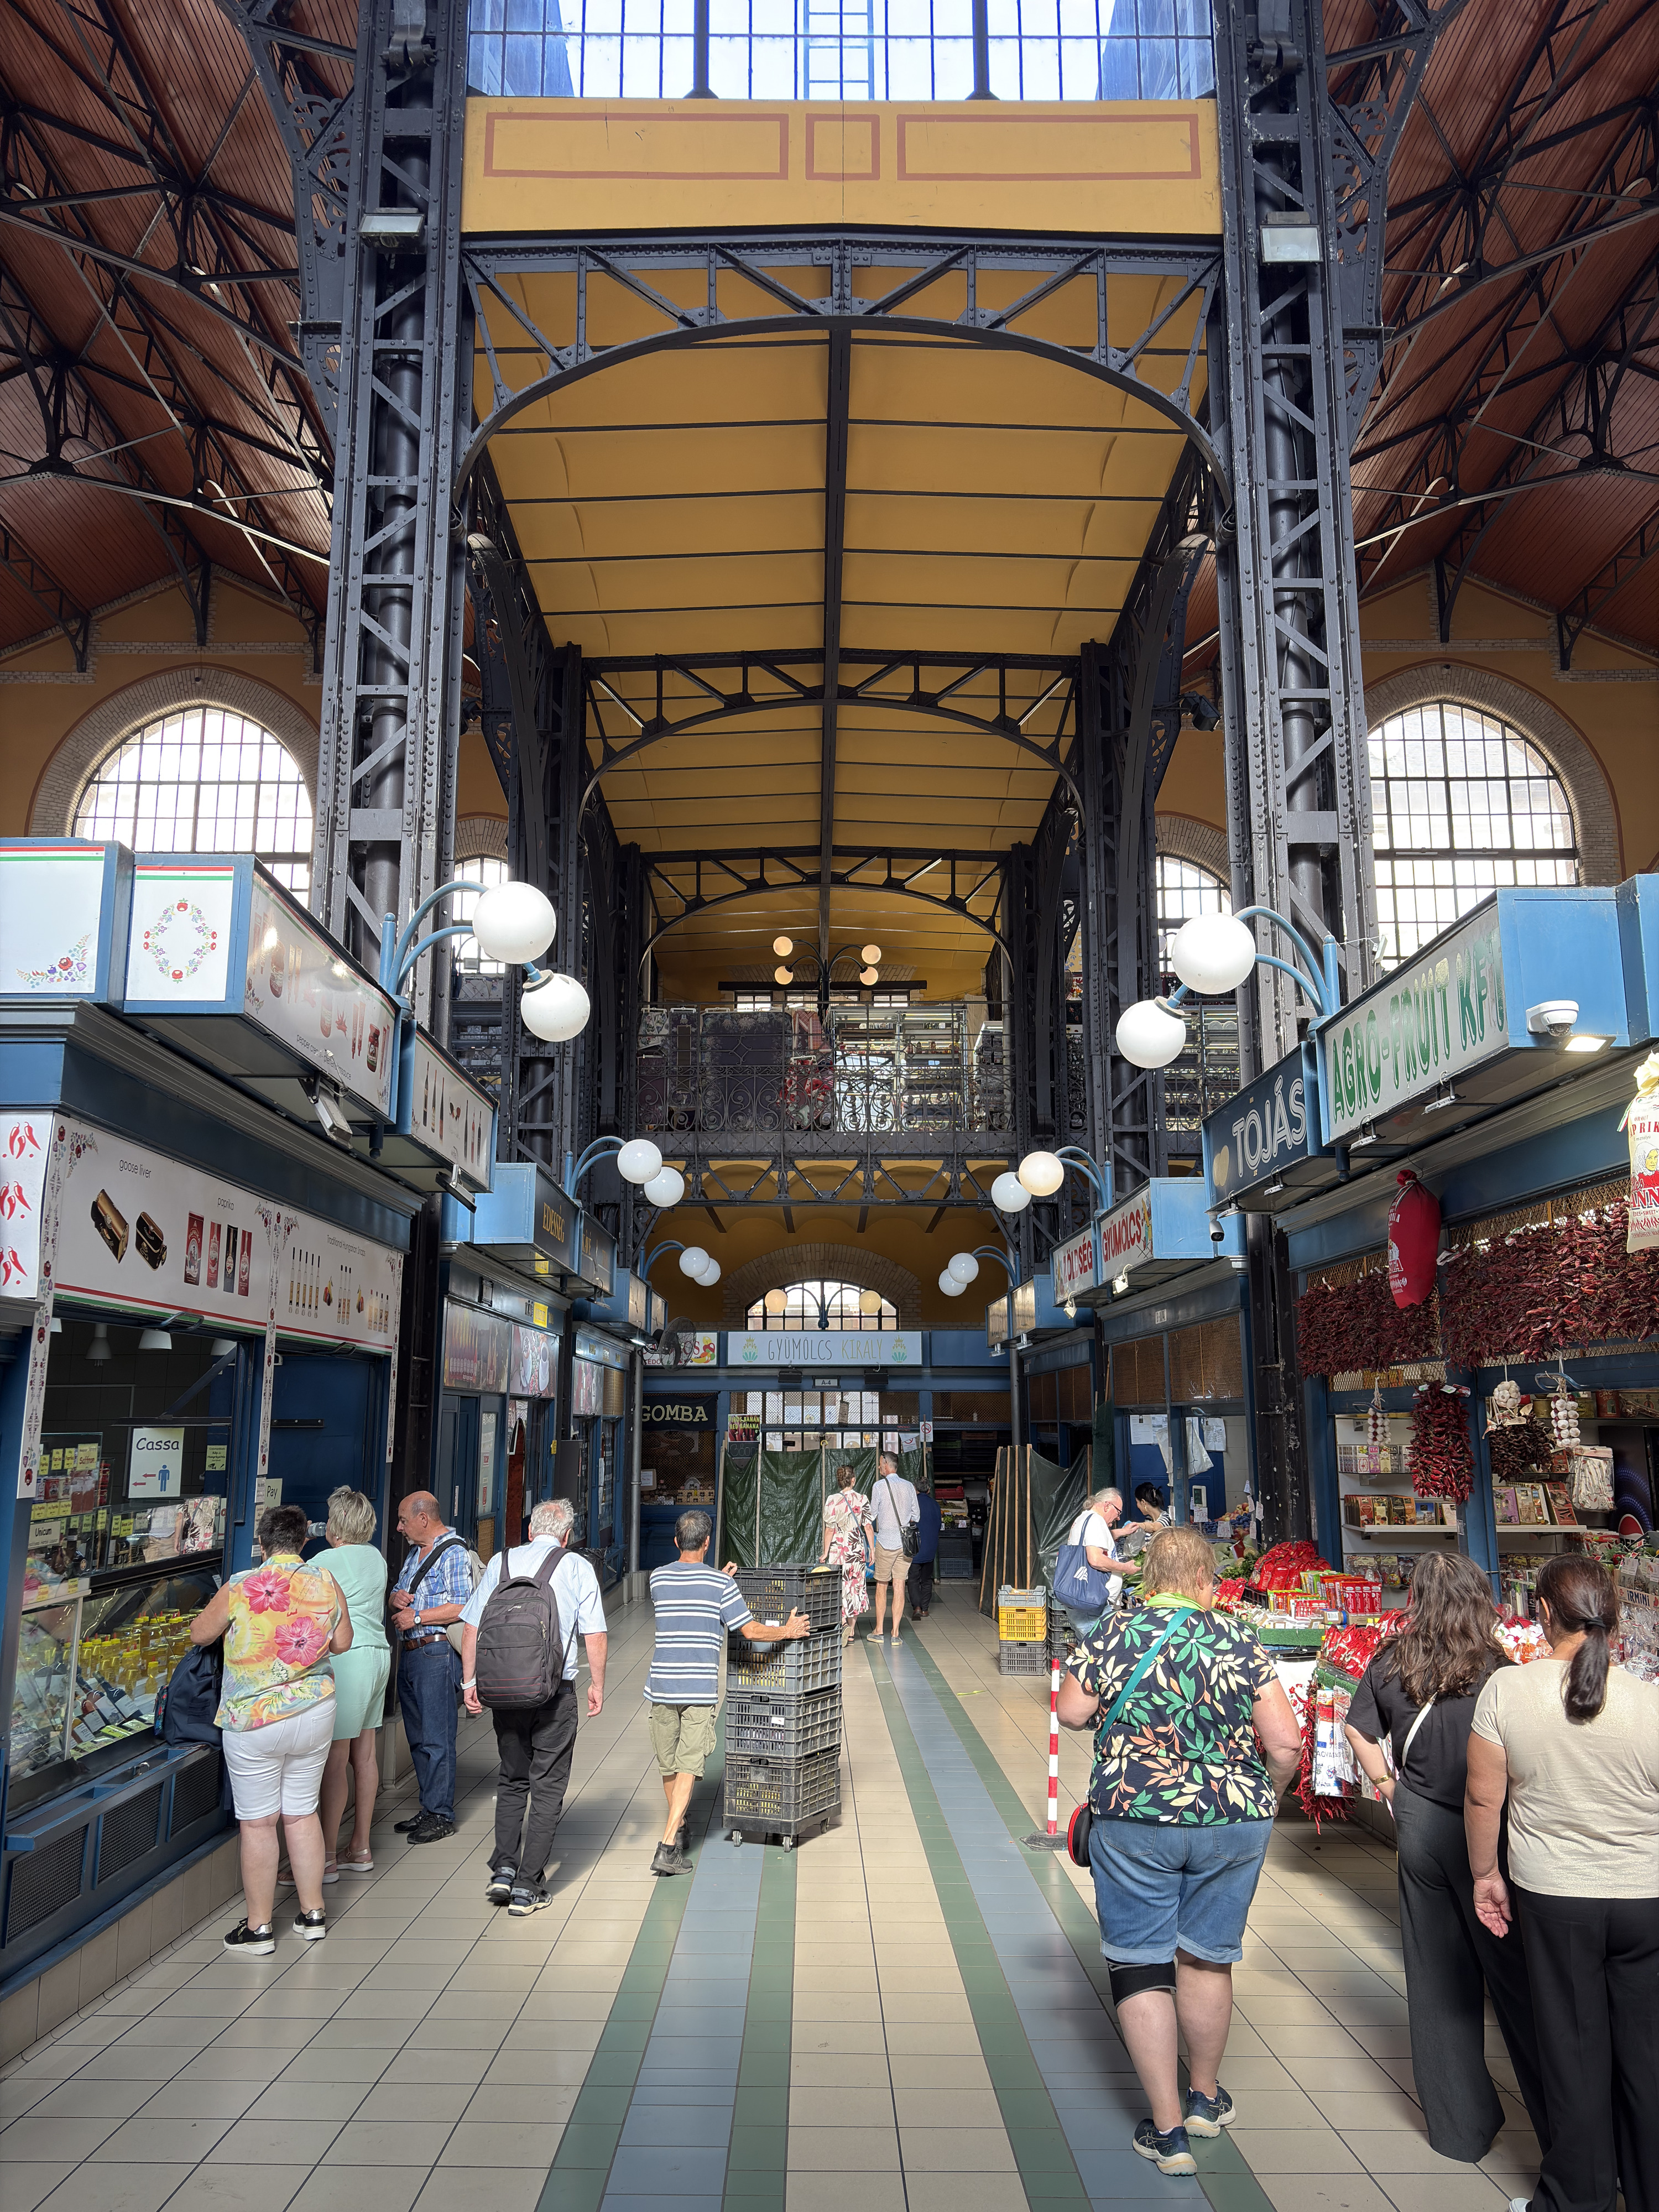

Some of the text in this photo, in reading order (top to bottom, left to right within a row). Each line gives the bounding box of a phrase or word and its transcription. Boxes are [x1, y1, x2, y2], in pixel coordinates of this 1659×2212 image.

[1333, 957, 1450, 1124] AGRO-FRUIT
[1232, 1074, 1306, 1177] TOJÁS
[1630, 1121, 1659, 1138] APRIK
[119, 1159, 152, 1178] goose liver
[217, 1197, 234, 1211] paprika
[1630, 1187, 1659, 1210] ANN
[327, 1235, 342, 1248] Traditional
[343, 1241, 357, 1253] Hungarian
[1102, 1209, 1141, 1263] GYÜMÖLCS
[1063, 1235, 1093, 1284] ZÖLDSÉG
[768, 1337, 883, 1360] GYÜMÖLCS KIRÁLY
[641, 1405, 708, 1422] GOMBA
[136, 1437, 180, 1451] Cassa
[267, 1485, 278, 1499] Pay
[35, 1527, 52, 1537] Unicum
